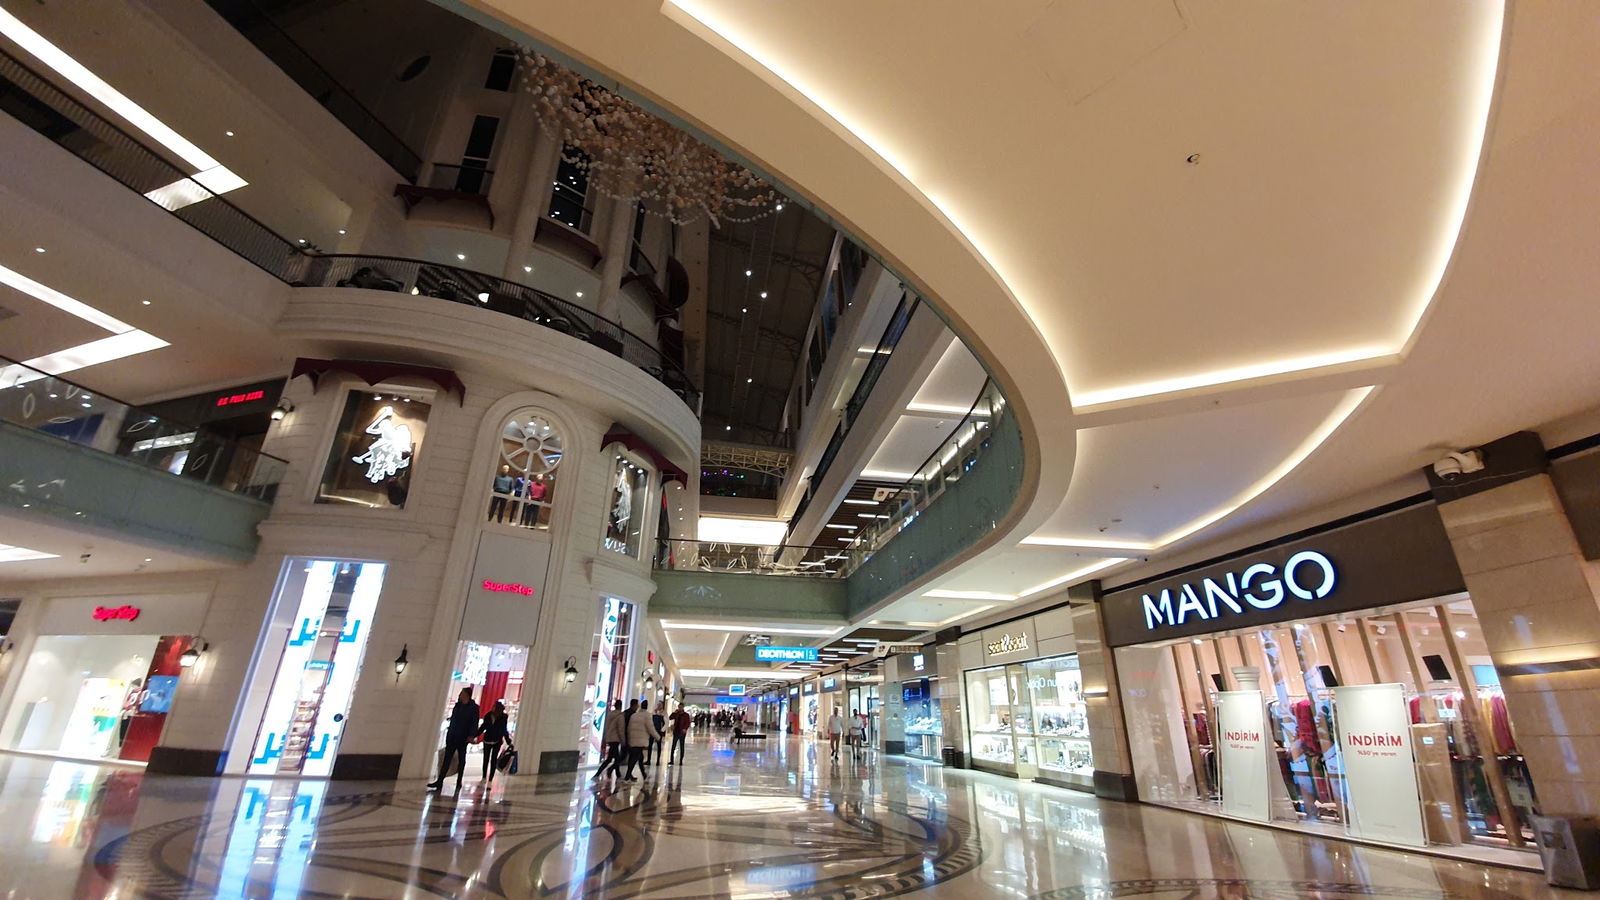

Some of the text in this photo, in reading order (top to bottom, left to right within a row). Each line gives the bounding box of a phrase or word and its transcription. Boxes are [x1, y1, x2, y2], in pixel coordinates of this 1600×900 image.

[482, 579, 535, 597] SuperStep
[1142, 550, 1336, 630] MANGO
[758, 648, 805, 659] DECATHLON
[1224, 729, 1260, 742] İNDİRİM
[1347, 732, 1403, 747] İNDİRİM
